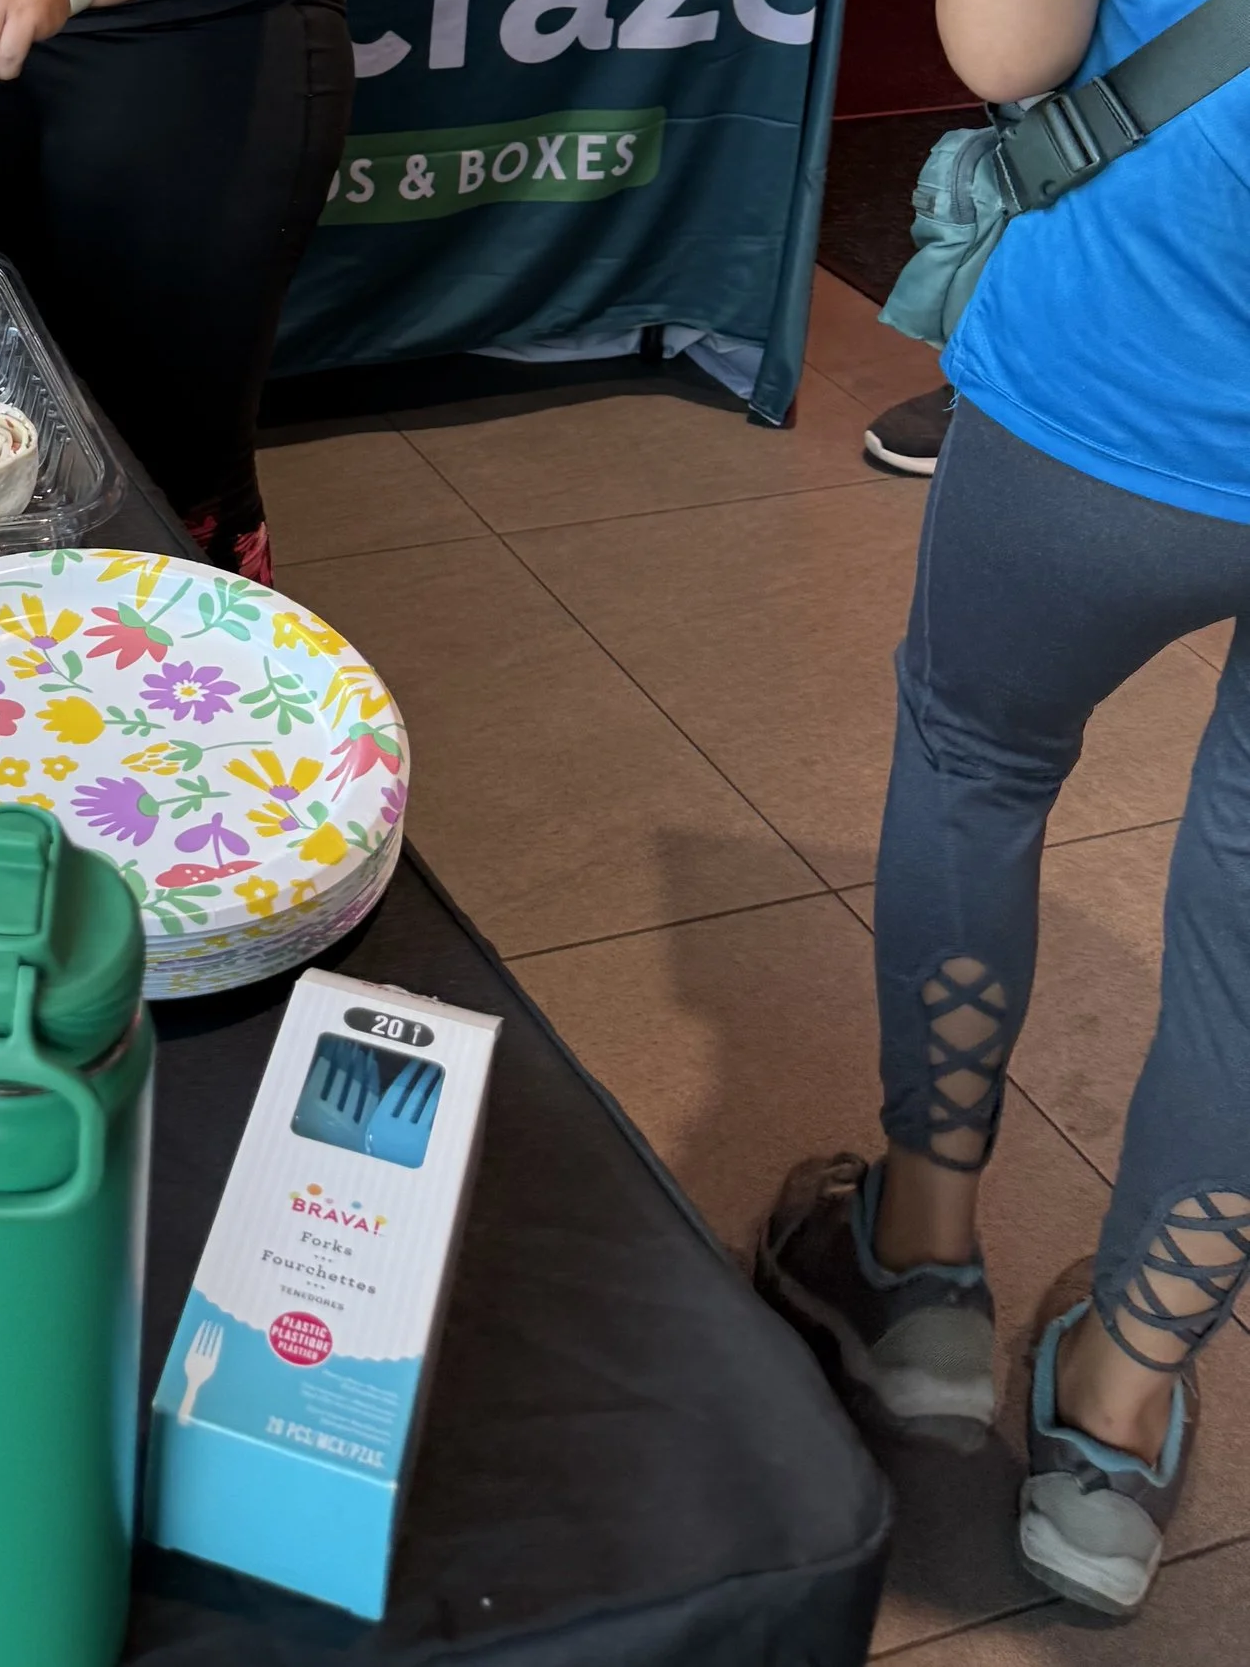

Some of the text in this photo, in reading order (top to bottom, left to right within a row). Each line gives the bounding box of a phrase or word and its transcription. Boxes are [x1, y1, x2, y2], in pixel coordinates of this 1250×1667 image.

[398, 131, 638, 202] & BOXES
[370, 1014, 406, 1040] 20
[291, 1196, 382, 1237] BRAVA!
[299, 1230, 354, 1258] Forks
[260, 1248, 378, 1297] Fourchettes
[278, 1283, 347, 1313] TENEDORES
[270, 1324, 332, 1355] PLASTIQUE
[281, 1315, 329, 1340] PLASTIC
